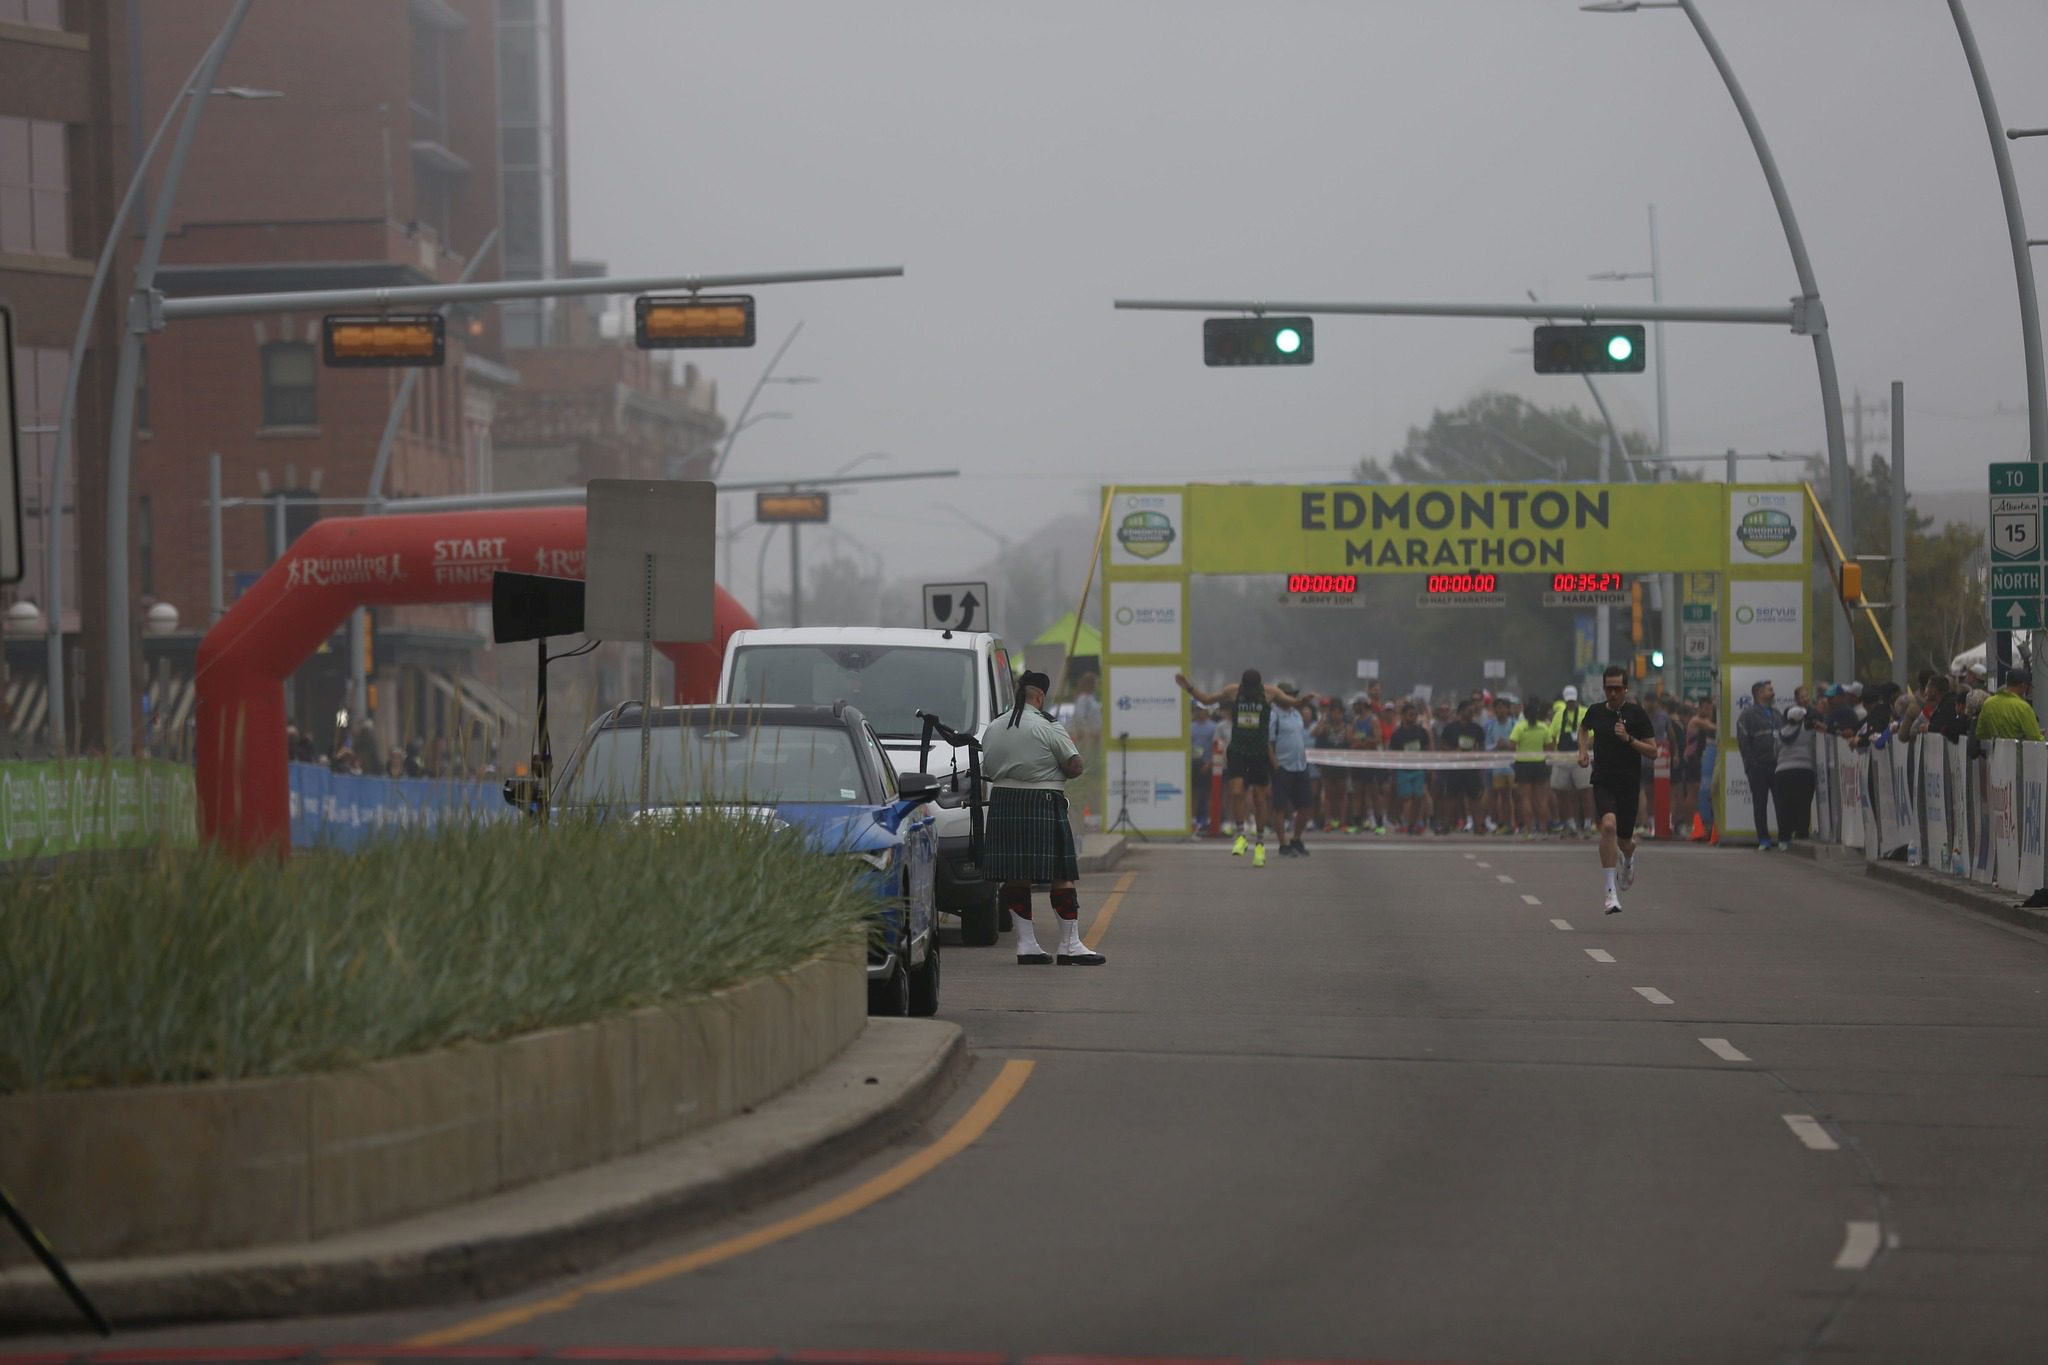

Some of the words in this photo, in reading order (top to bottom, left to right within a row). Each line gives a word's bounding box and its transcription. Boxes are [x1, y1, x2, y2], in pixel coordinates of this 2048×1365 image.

[2005, 470, 2024, 487] TO
[1301, 491, 1609, 531] EDMONTON
[2005, 524, 2026, 542] 15
[433, 538, 507, 560] START
[1346, 538, 1564, 567] MARATHON
[436, 565, 508, 584] FINIS
[1994, 573, 2039, 590] NORTH
[1562, 594, 1625, 605] MARATHON
[1756, 607, 1796, 616] servus
